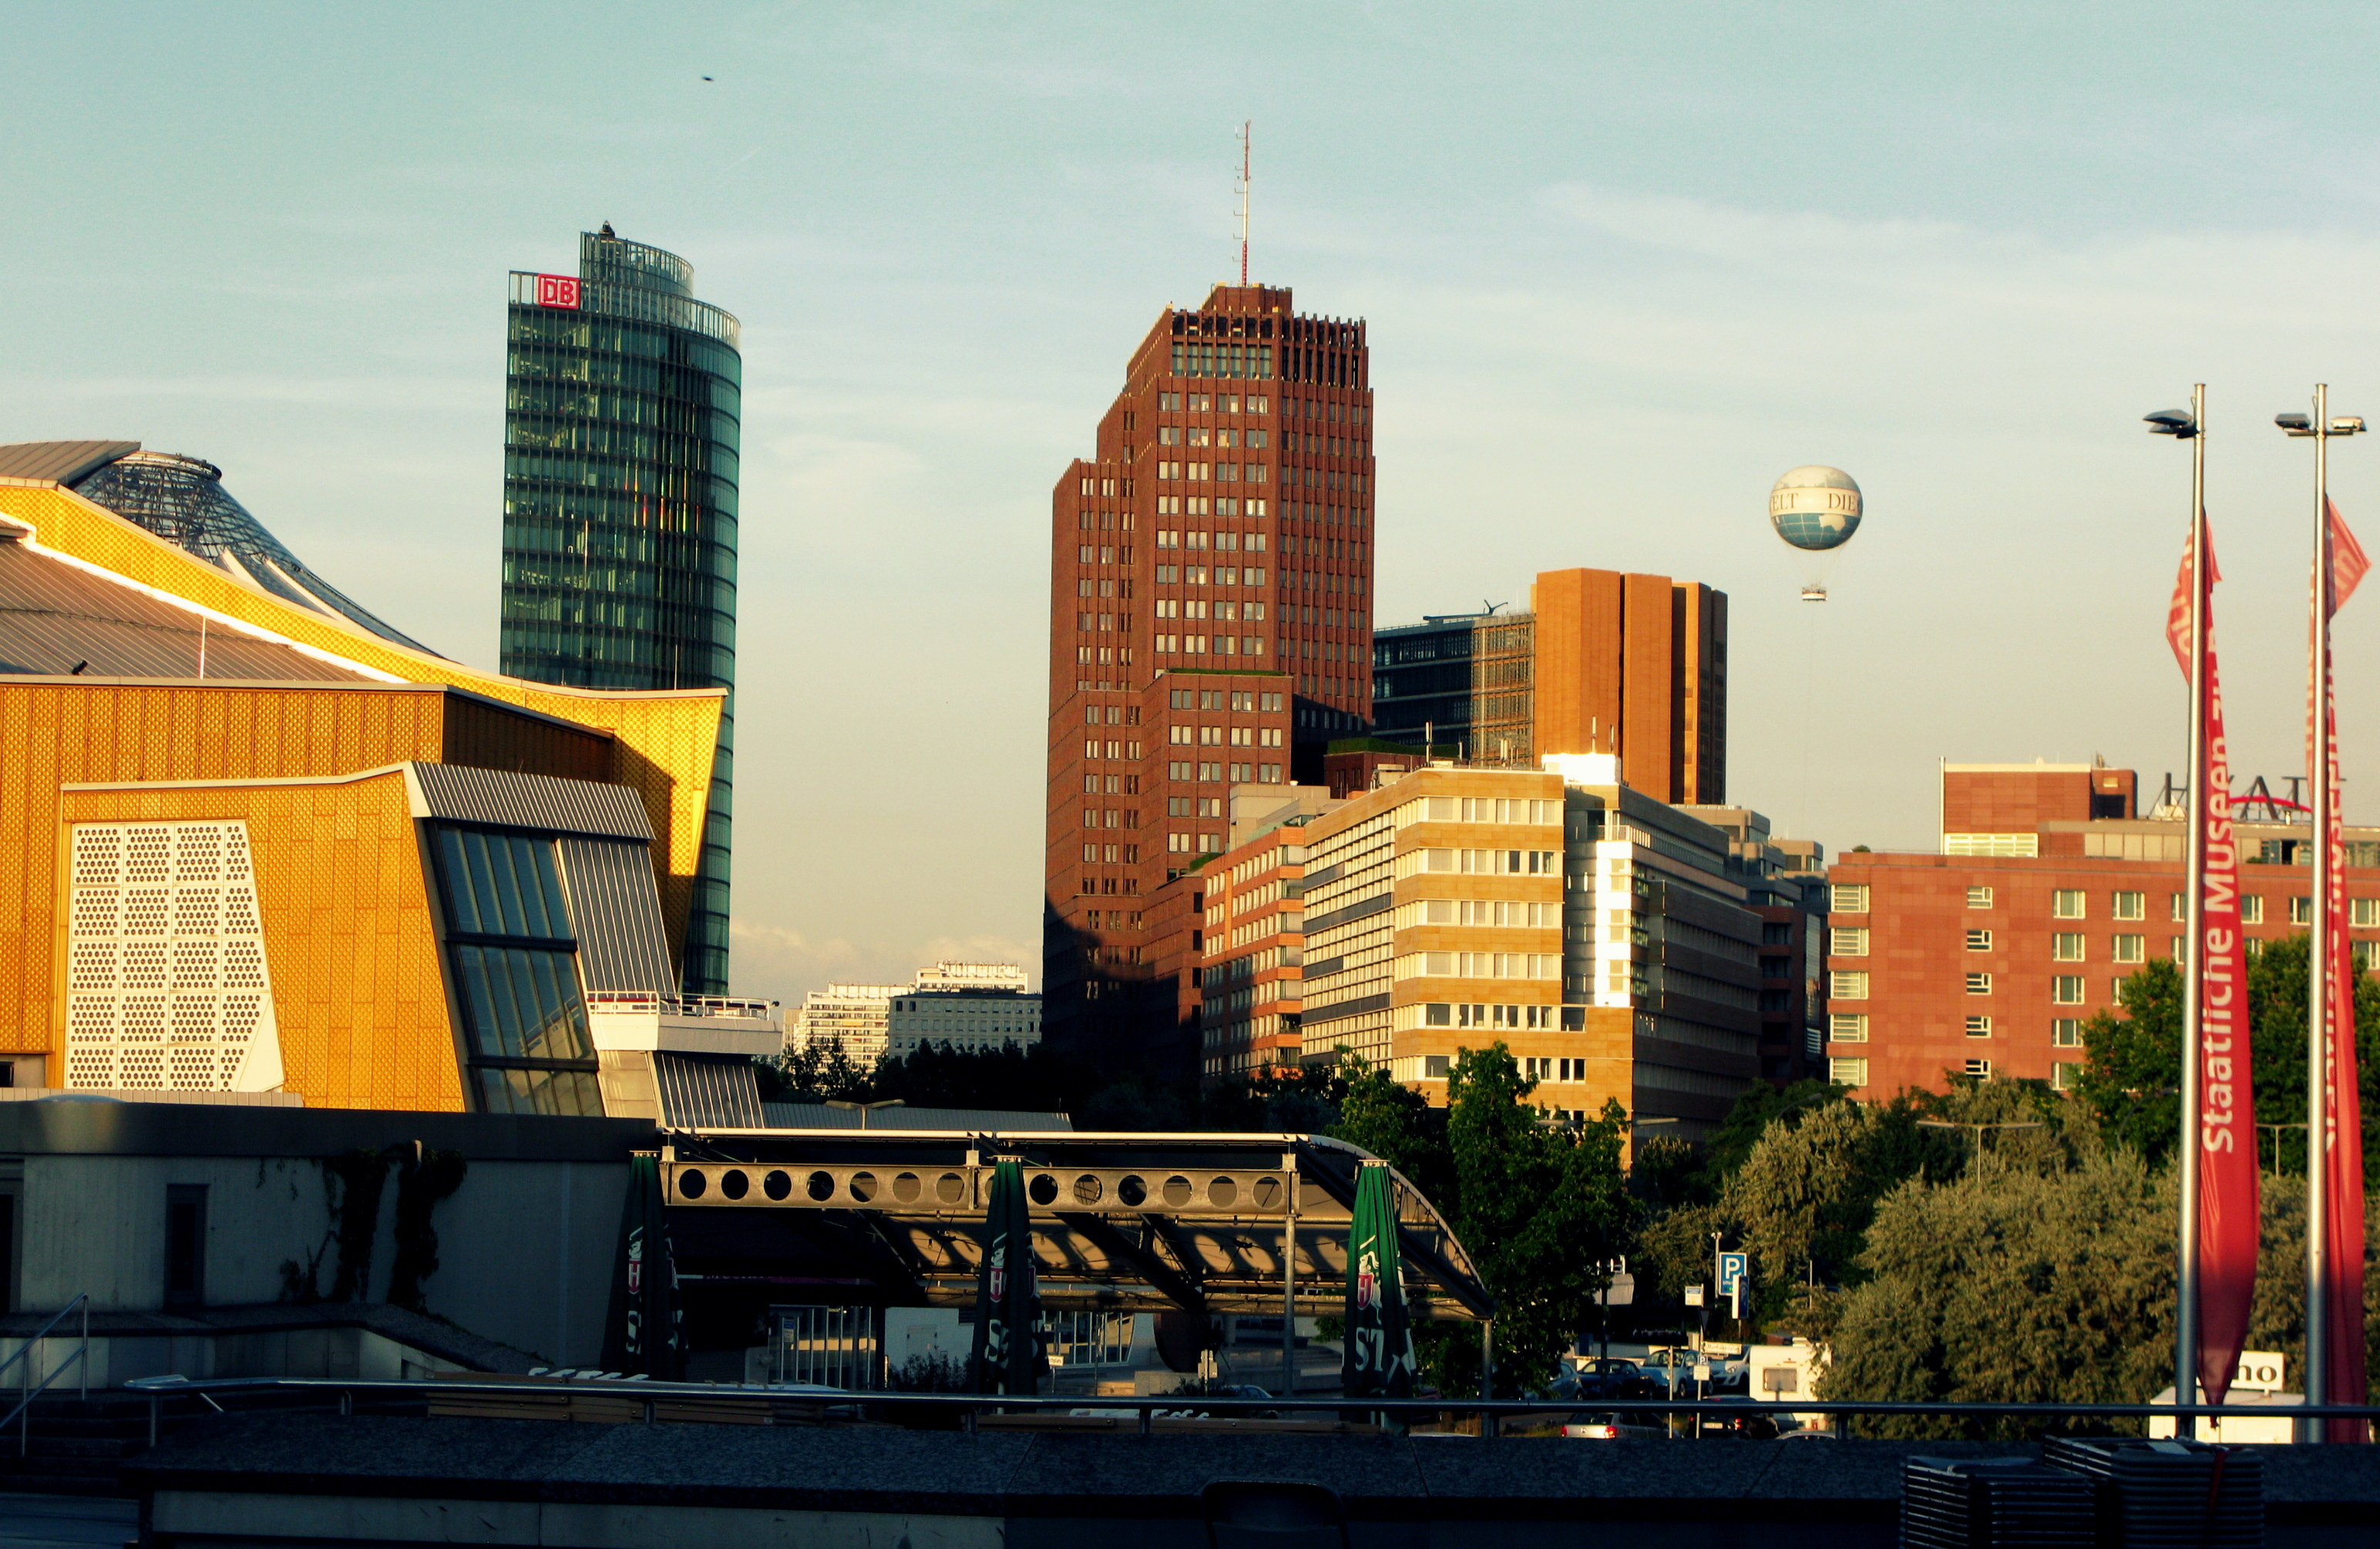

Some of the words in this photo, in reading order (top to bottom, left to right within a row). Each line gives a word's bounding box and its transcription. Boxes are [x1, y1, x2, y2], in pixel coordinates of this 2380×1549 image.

[543, 280, 573, 304] DB
[1770, 493, 1799, 512] ELT
[1828, 492, 1856, 512] DIE
[2204, 736, 2236, 913] Museen
[2202, 927, 2234, 1153] Staatliche
[1725, 1257, 1740, 1279] P
[990, 1270, 1003, 1295] H
[1357, 1277, 1370, 1304] H
